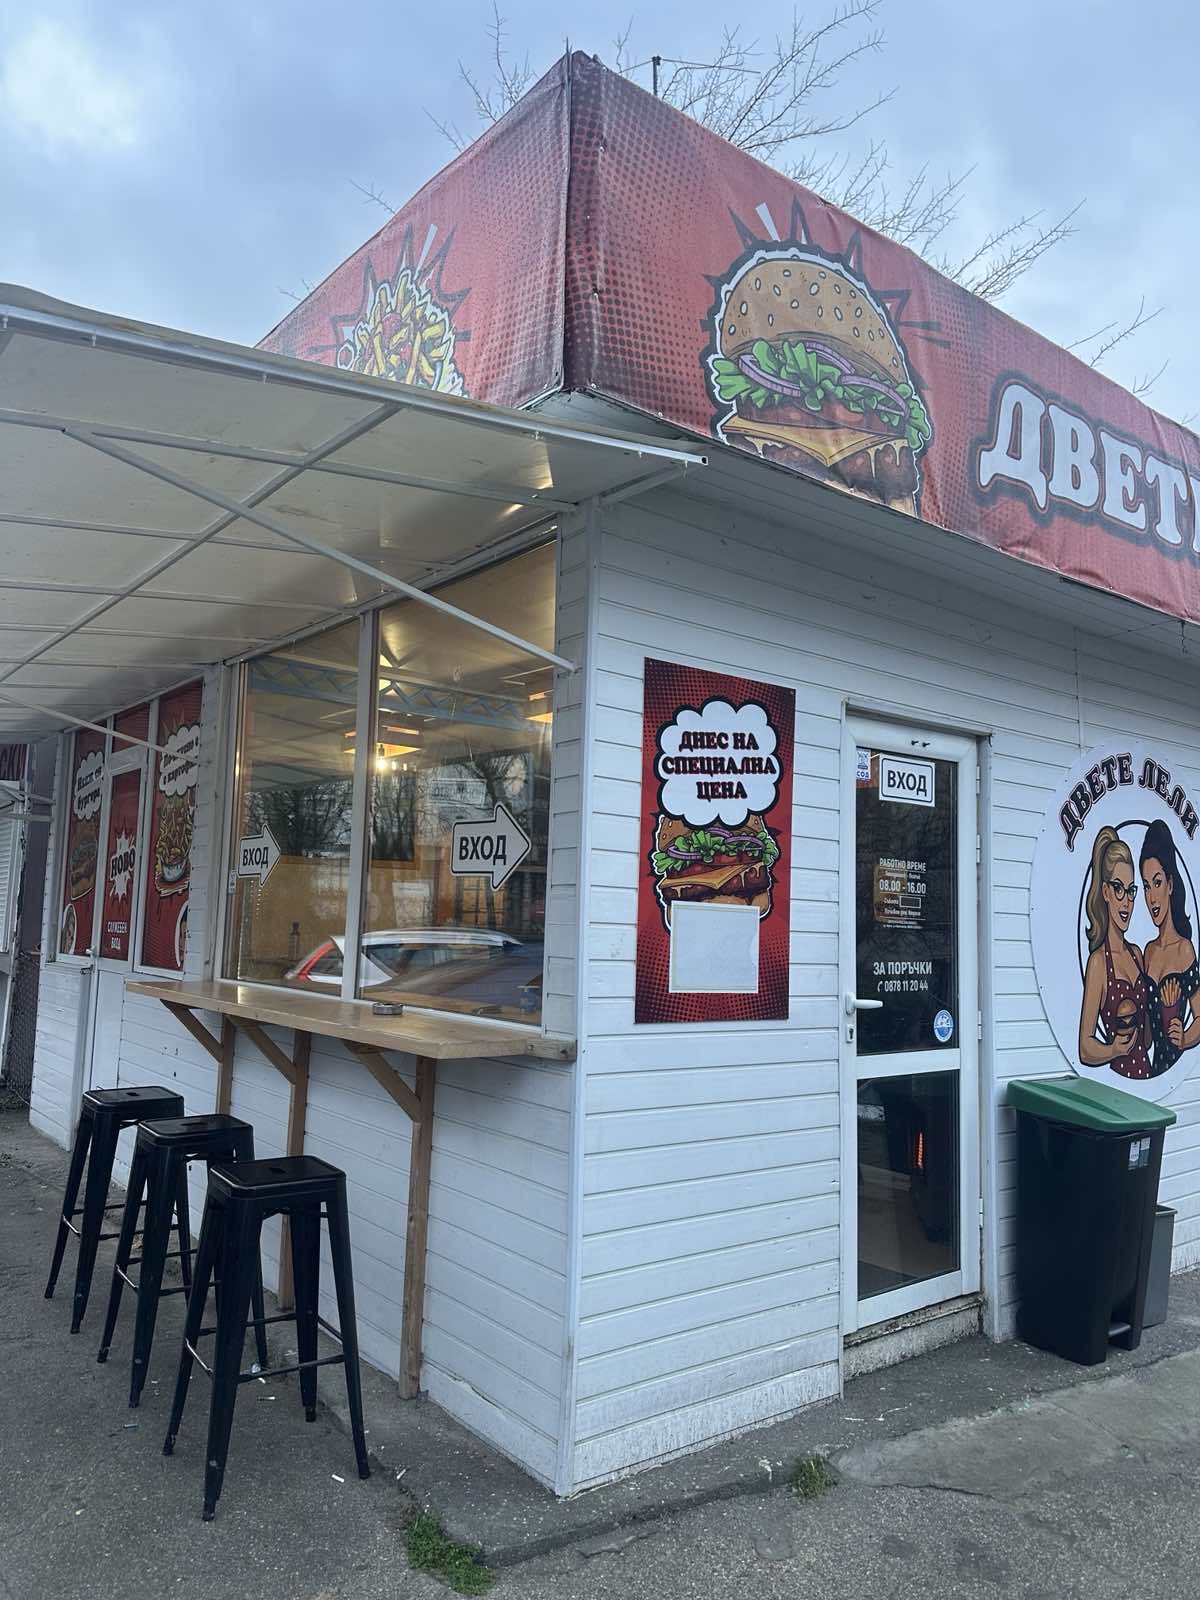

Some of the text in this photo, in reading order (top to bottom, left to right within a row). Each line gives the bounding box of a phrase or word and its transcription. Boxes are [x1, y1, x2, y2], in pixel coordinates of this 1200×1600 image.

[979, 383, 1200, 554] ДВЕТ
[679, 731, 759, 752] ДНЕС НА
[662, 757, 777, 777] СПЕЦИАЛНА
[696, 782, 747, 802] ЦЕНА
[887, 770, 927, 797] ВХОД
[1060, 753, 1199, 852] ДВЕТЕ ЛЕЛЯ
[242, 847, 269, 869] ВХОД
[459, 835, 507, 866] ВХОД
[111, 848, 136, 879] НОВО
[880, 858, 926, 871] РАБОТНО ВРЕМЕ
[880, 880, 901, 891] 08.00
[907, 882, 926, 894] 16.00
[873, 962, 932, 975] ЗА ПОРЪЧКИ
[884, 980, 901, 992] 0878
[910, 980, 919, 992] 20
